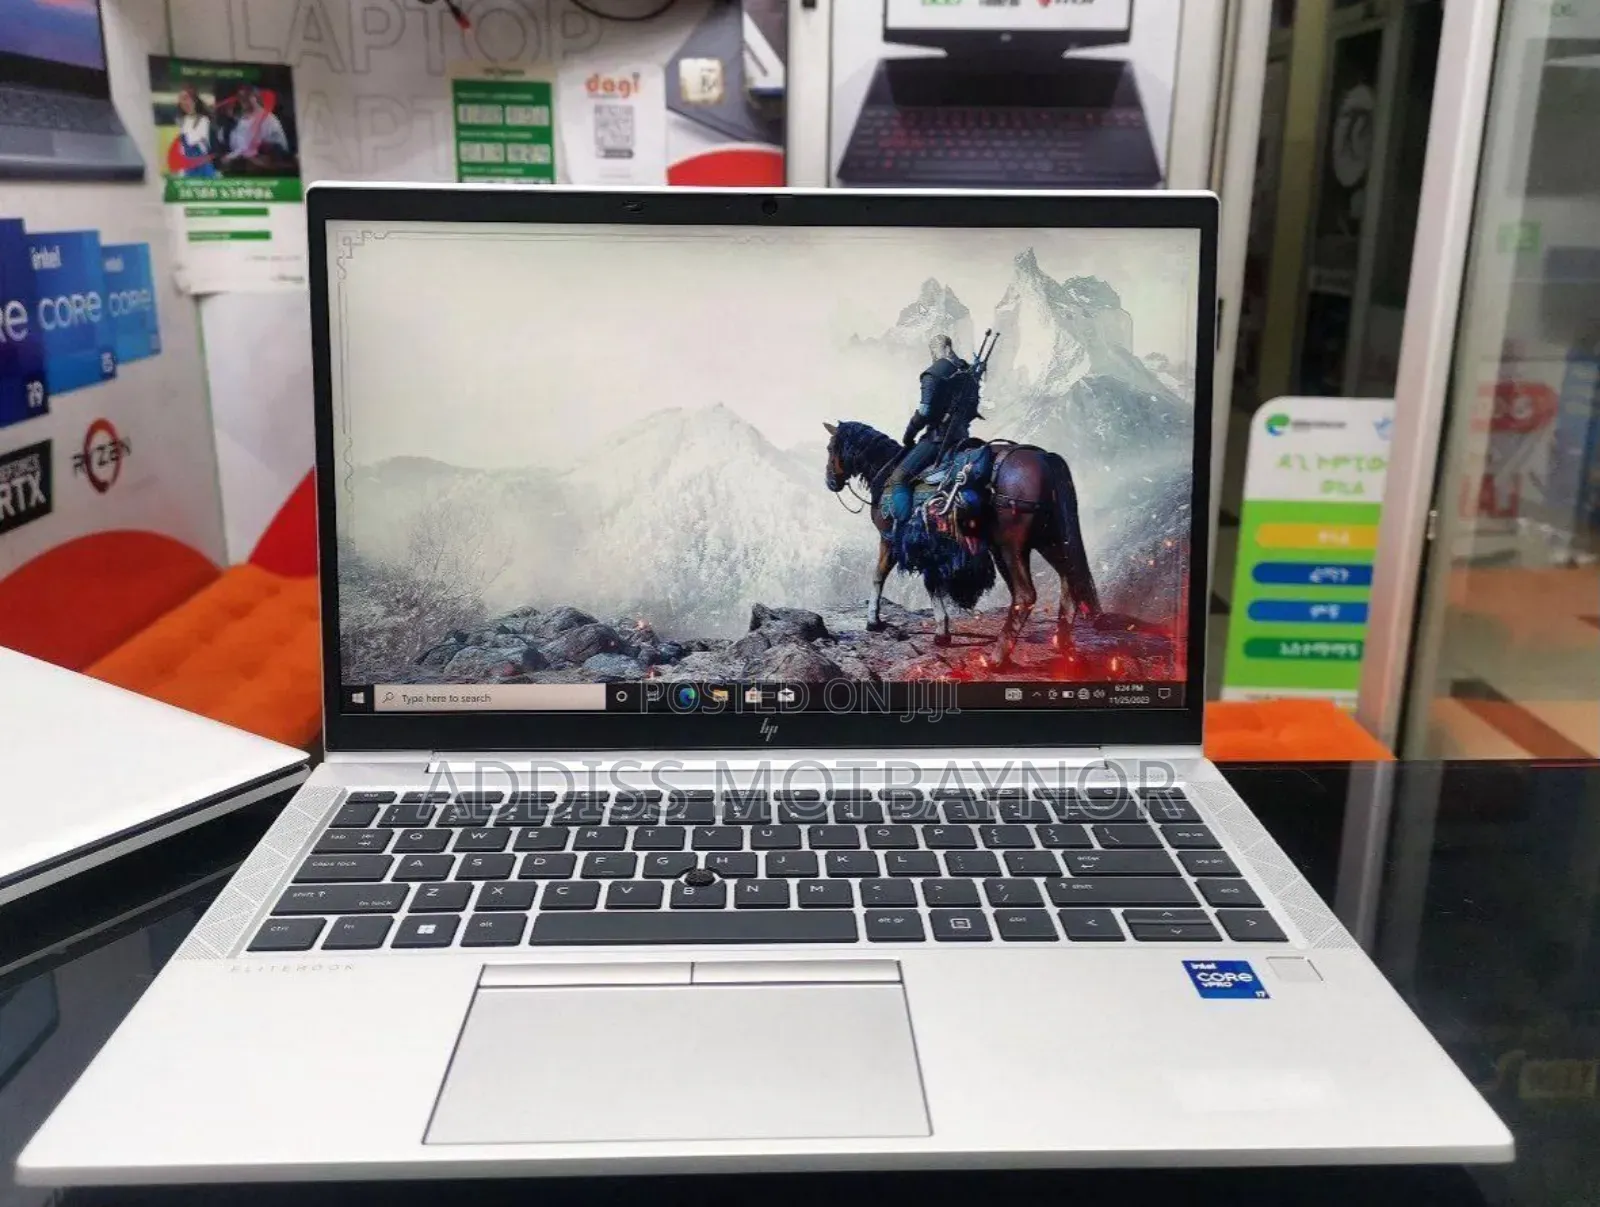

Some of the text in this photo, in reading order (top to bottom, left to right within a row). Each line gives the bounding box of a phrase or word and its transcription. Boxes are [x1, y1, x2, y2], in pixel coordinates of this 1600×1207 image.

[226, 0, 601, 77] LAPTOP
[0, 471, 46, 520] RTX
[401, 693, 492, 705] Type here to search
[759, 717, 779, 742] hp
[409, 832, 423, 840] Q
[471, 832, 488, 840] W
[645, 829, 655, 837] T
[761, 829, 773, 837] U
[819, 829, 824, 837] I
[877, 828, 890, 837] O
[410, 859, 423, 867] A
[471, 858, 483, 866] S
[533, 857, 546, 865] D
[594, 856, 607, 864] F
[656, 856, 669, 865] G
[716, 856, 729, 864] H
[777, 855, 786, 864] J
[837, 855, 848, 863] K
[897, 855, 907, 863] L
[426, 888, 440, 897] Z
[491, 886, 504, 895] X
[556, 886, 569, 895] C
[621, 886, 634, 894] V
[683, 886, 695, 895] B
[746, 885, 759, 893] N
[810, 885, 824, 893] M
[1197, 972, 1253, 982] CORE
